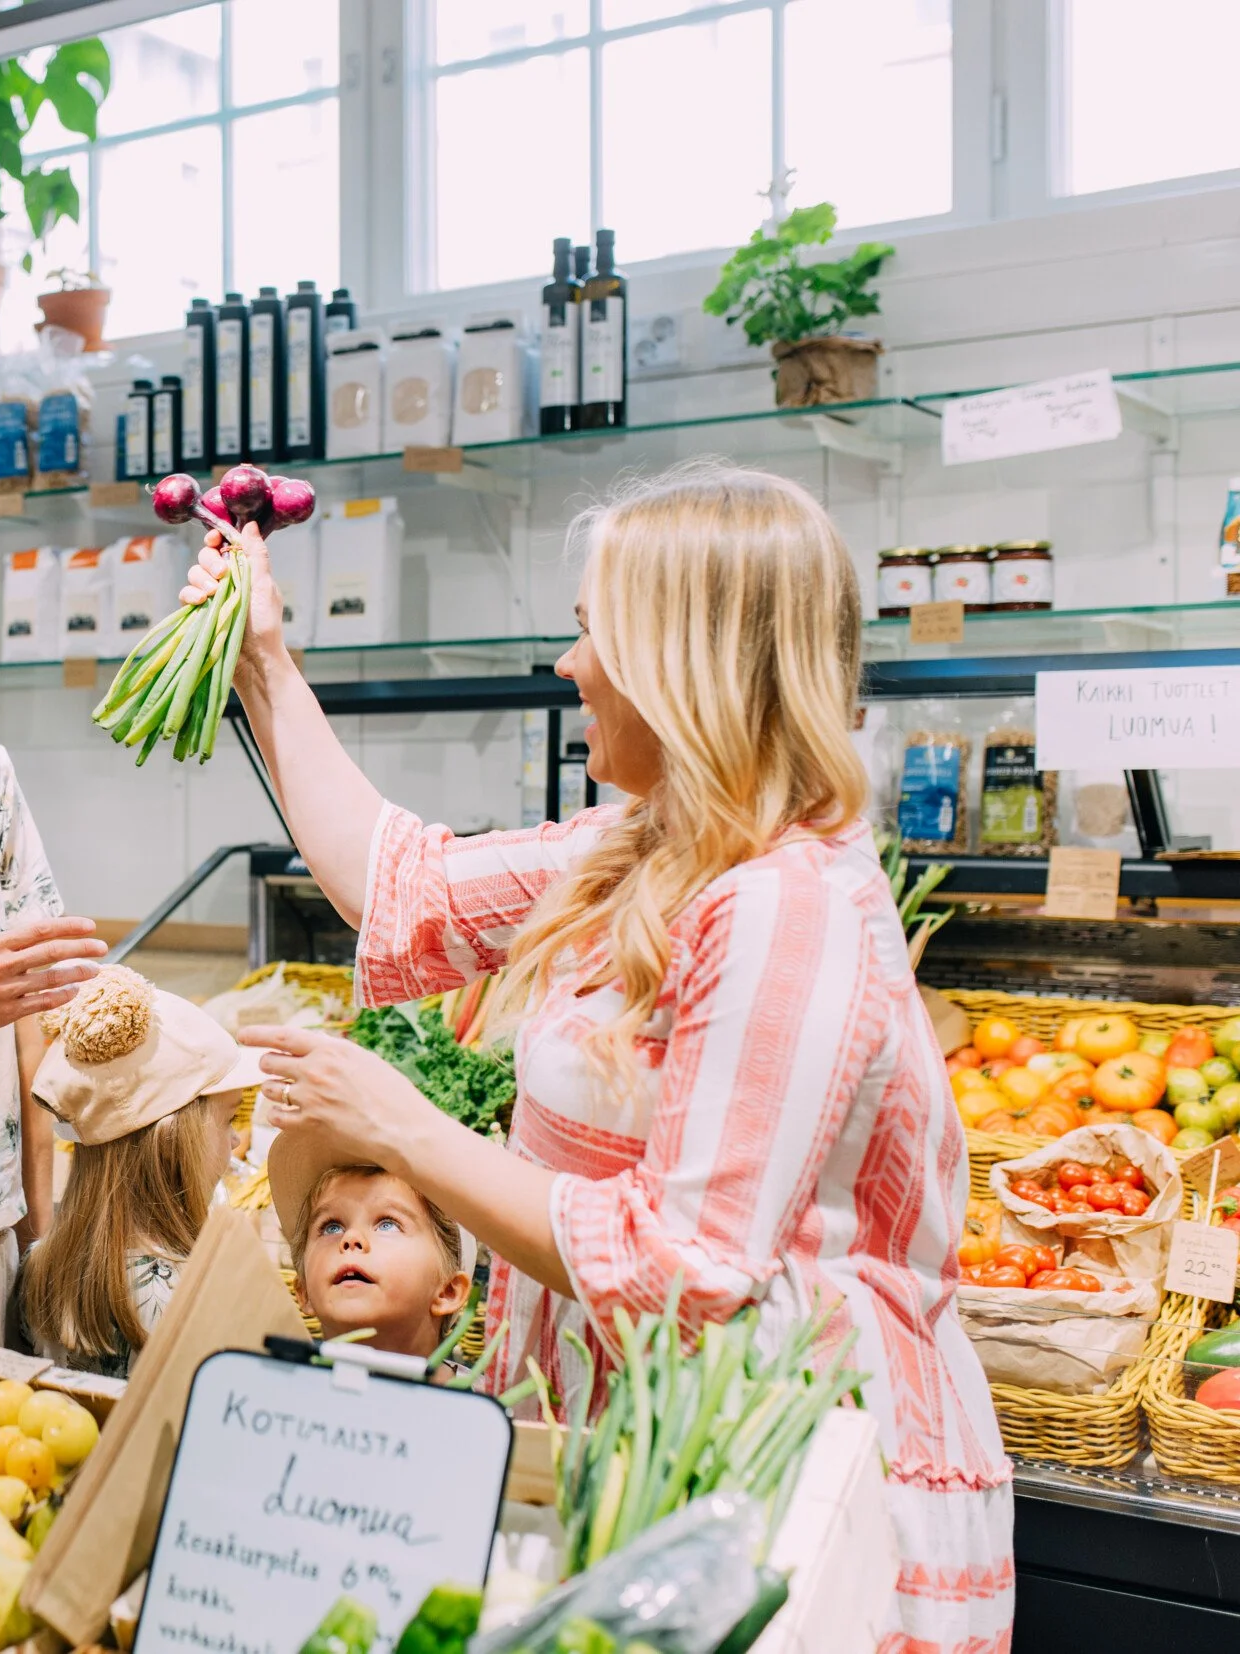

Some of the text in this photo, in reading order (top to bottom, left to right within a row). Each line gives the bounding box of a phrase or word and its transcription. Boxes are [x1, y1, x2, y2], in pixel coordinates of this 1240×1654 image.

[1077, 680, 1133, 703] KAIKKI
[1109, 714, 1195, 742] LUOMUA
[221, 1389, 410, 1459] KOTIMAISTA
